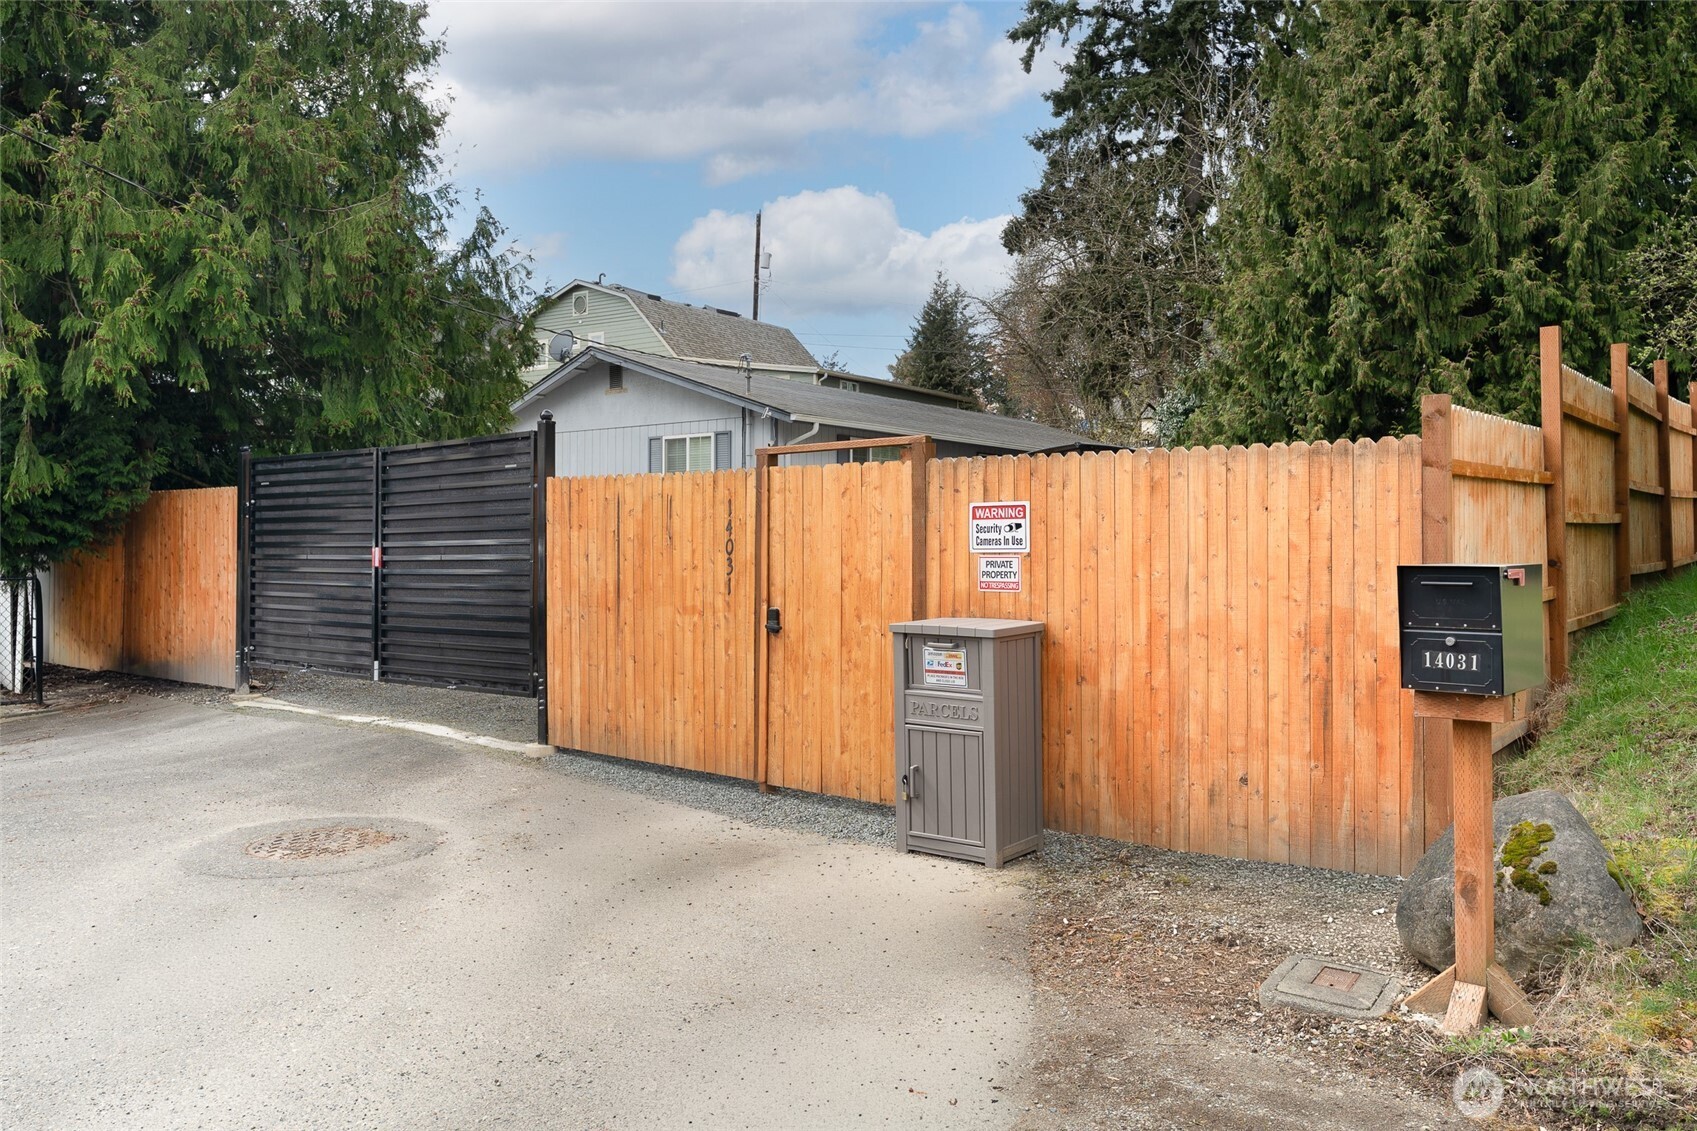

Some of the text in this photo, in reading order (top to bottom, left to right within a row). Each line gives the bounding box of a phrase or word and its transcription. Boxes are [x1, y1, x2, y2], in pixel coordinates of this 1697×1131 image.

[975, 507, 1024, 519] WARNING
[975, 523, 1003, 535] Security
[975, 535, 1024, 546] Cameras In Use
[725, 498, 734, 596] 14031
[985, 560, 1014, 569] PRIVATE
[981, 570, 1018, 579] PROPERTY
[989, 582, 1019, 590] TRESPASSING
[937, 660, 953, 668] FedEx
[1424, 651, 1478, 671] 14031
[910, 700, 979, 721] PARCELS
